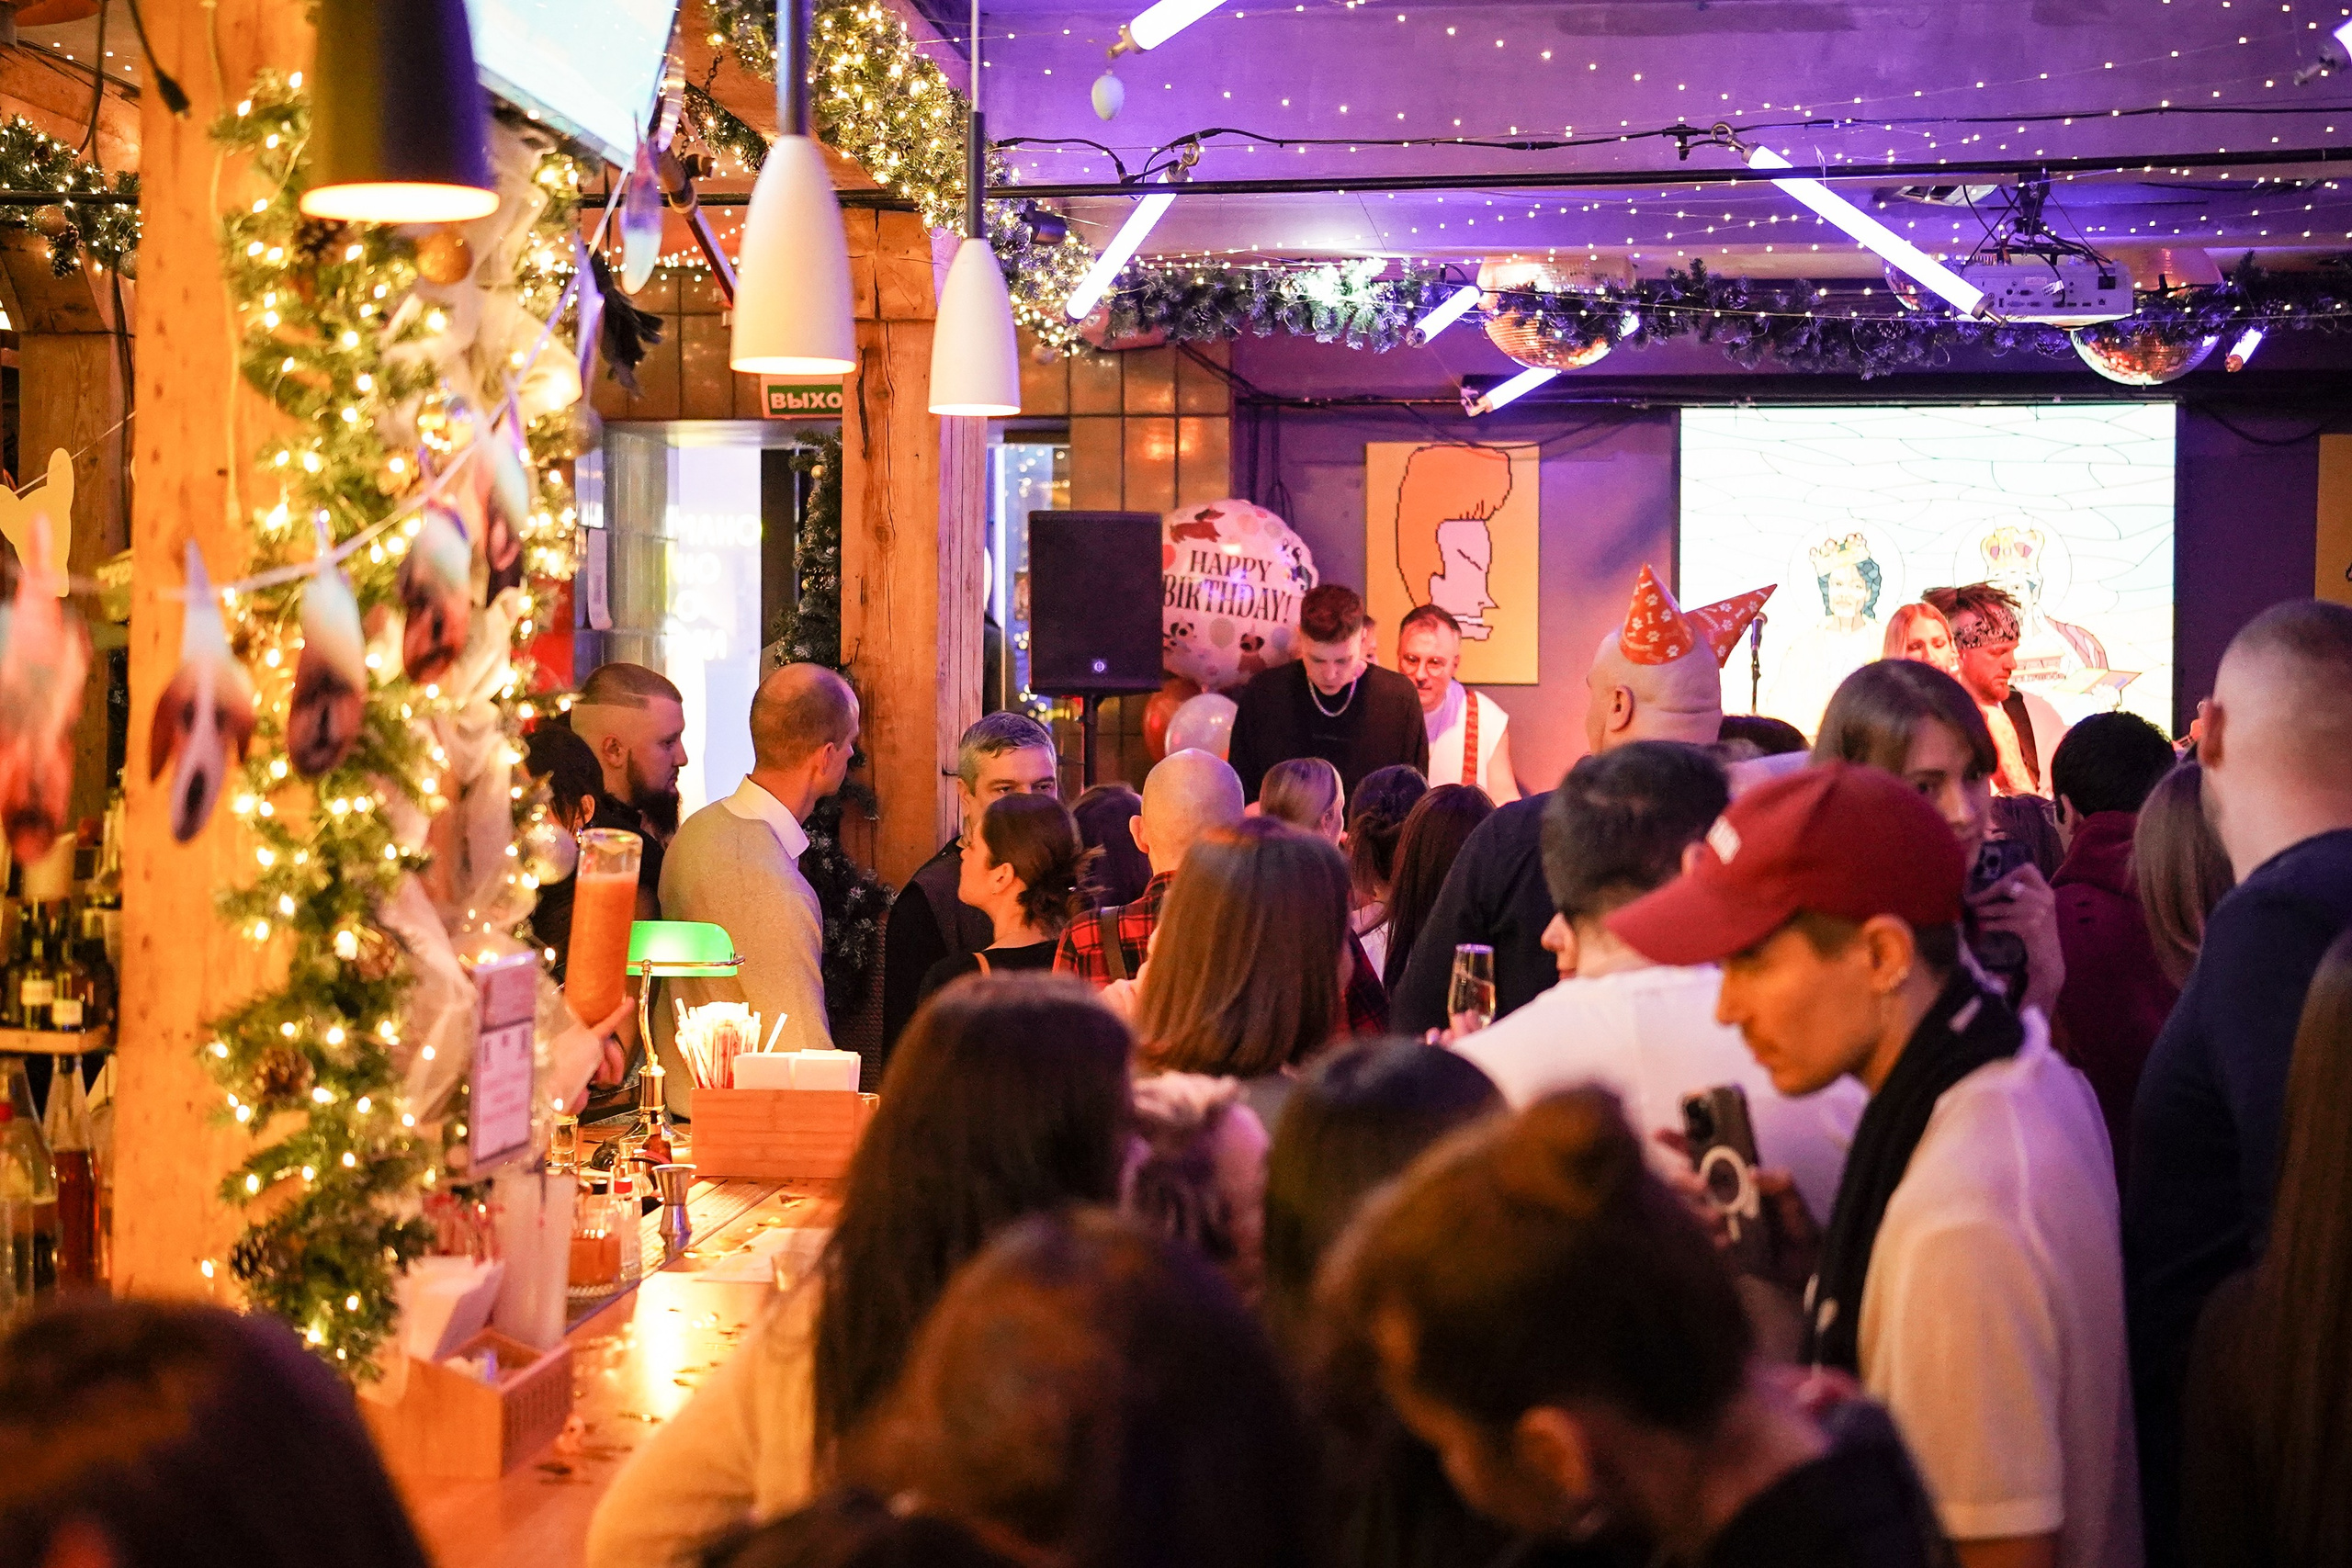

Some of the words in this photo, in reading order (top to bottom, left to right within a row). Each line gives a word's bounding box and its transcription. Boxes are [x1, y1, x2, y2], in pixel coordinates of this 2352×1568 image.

[770, 391, 842, 410] ВЫХО
[1190, 549, 1272, 583] HAPPY
[1163, 573, 1294, 624] BIRTHDAY!
